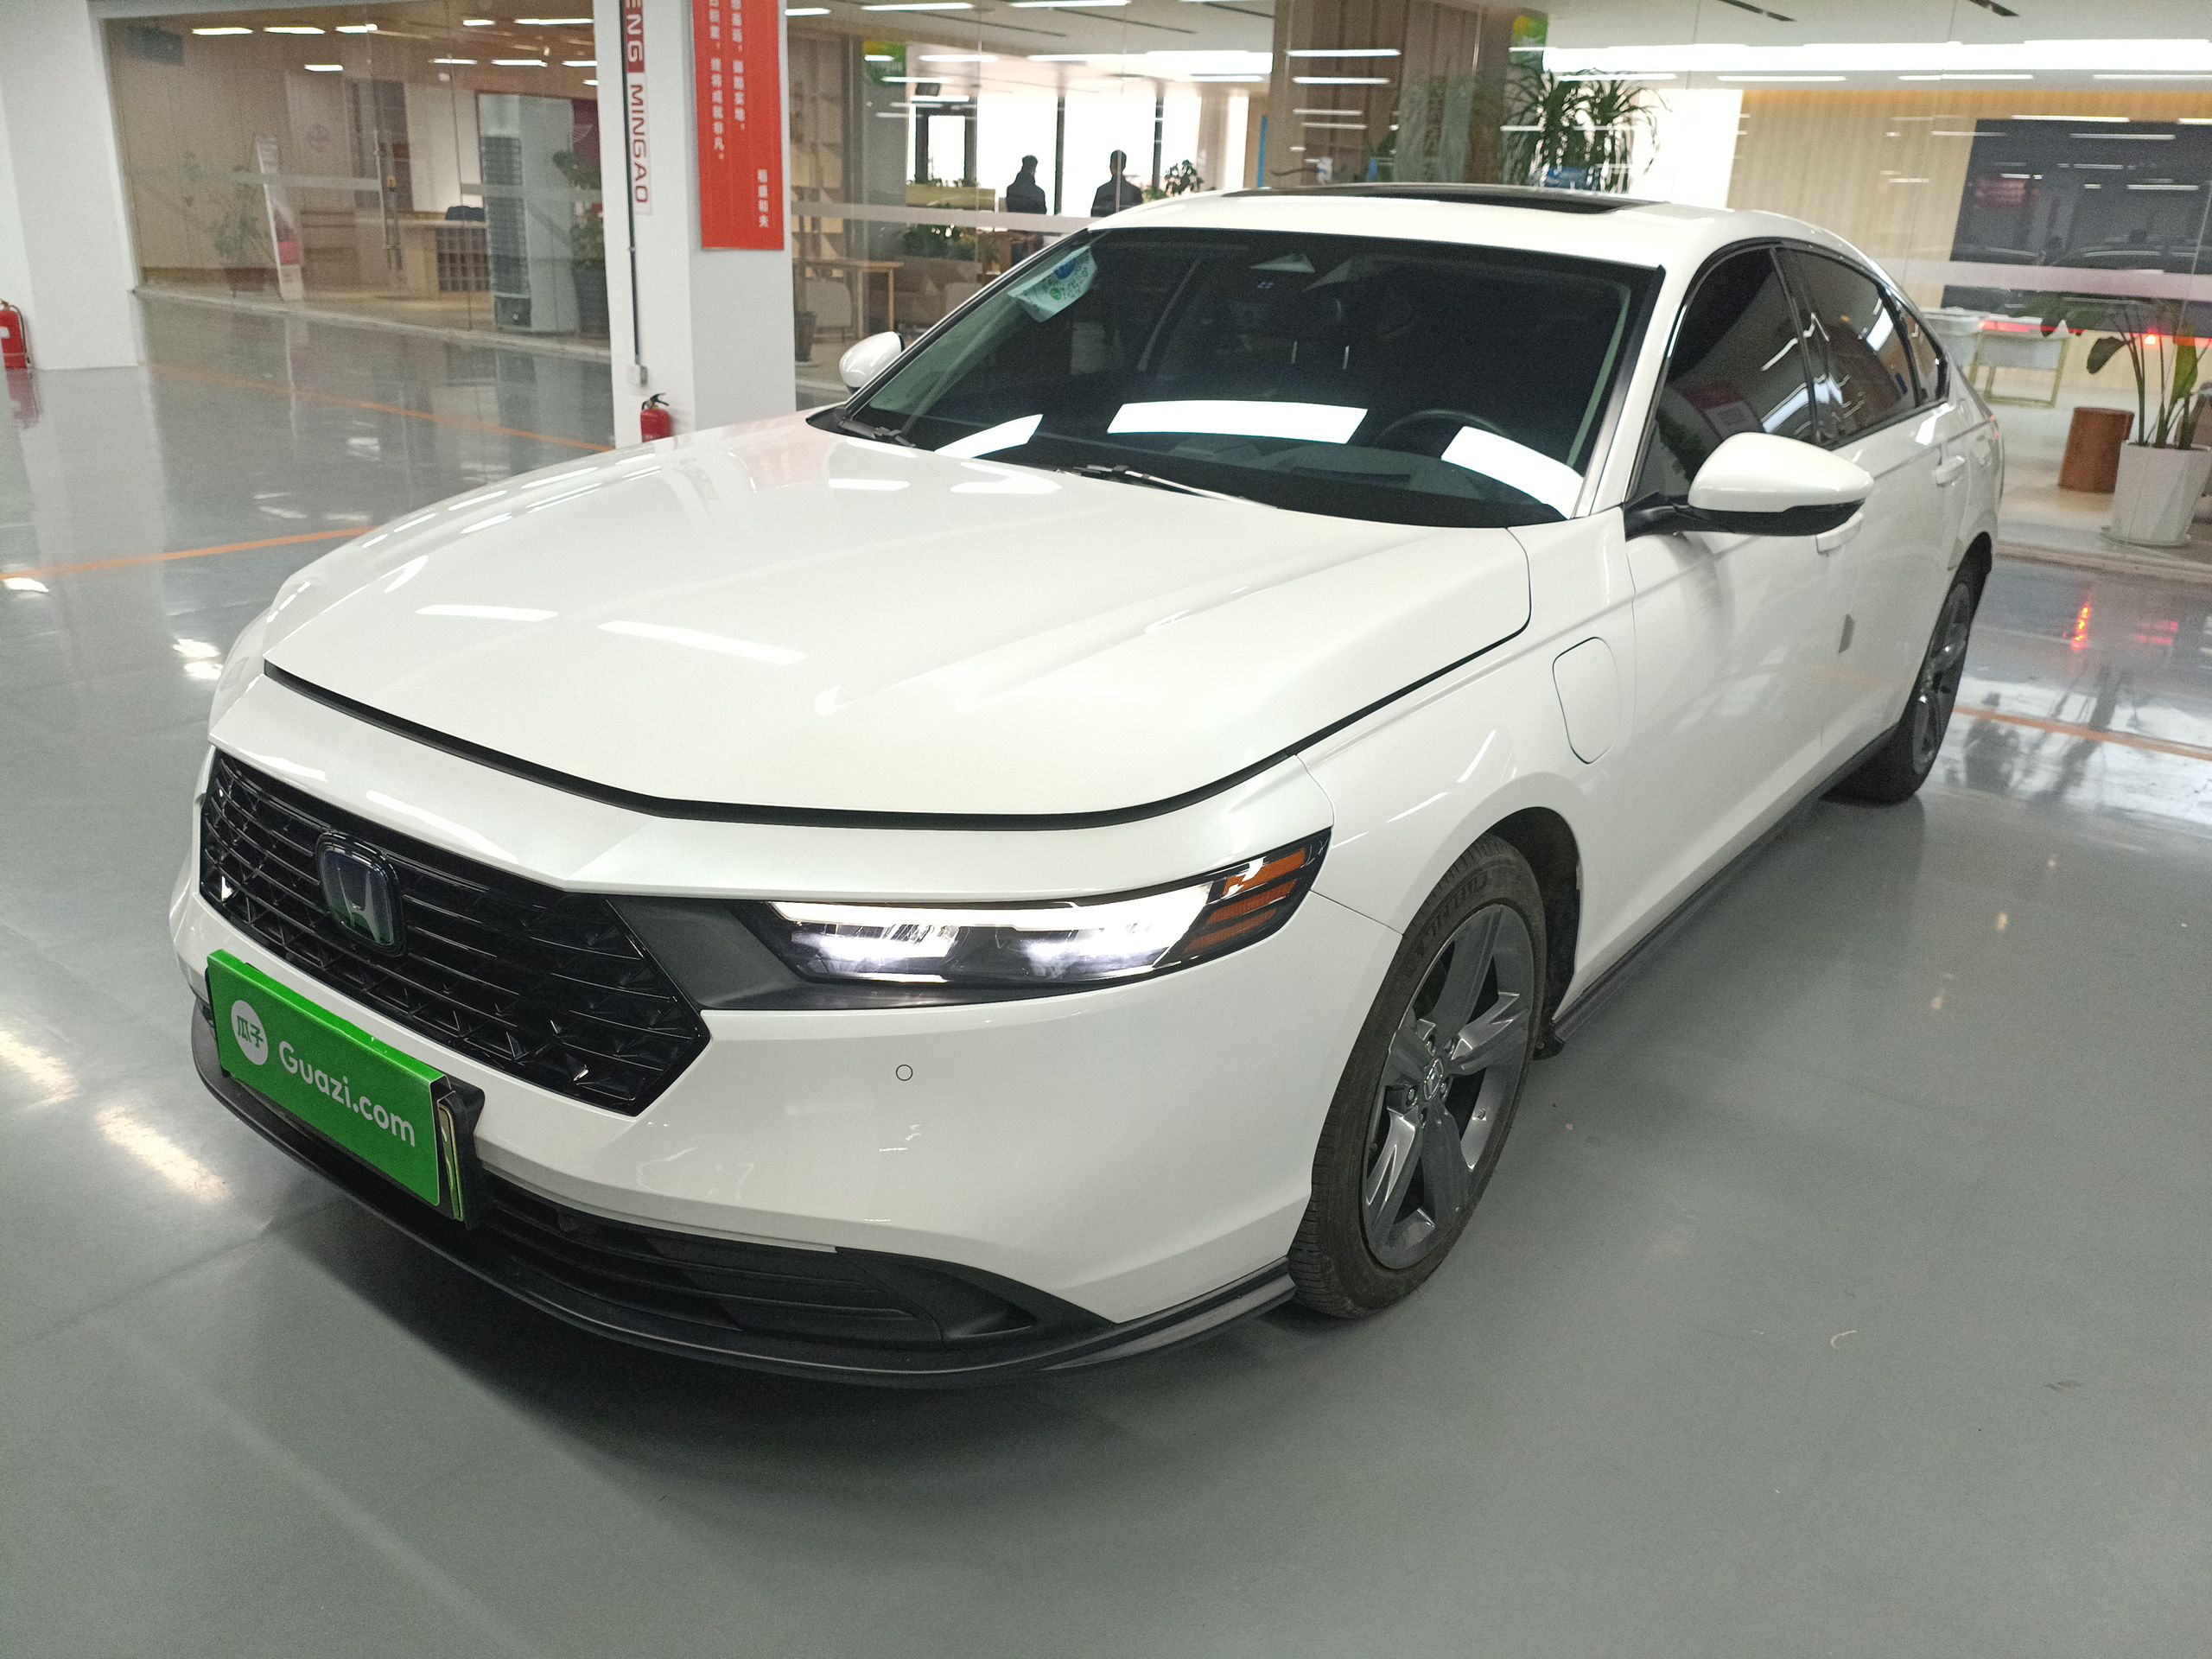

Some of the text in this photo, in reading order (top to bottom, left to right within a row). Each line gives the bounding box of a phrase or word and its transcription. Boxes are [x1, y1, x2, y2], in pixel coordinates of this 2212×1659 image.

[631, 84, 649, 203] MINGAO
[237, 1015, 264, 1048] 瓜子
[279, 1041, 416, 1147] Guazi.com
